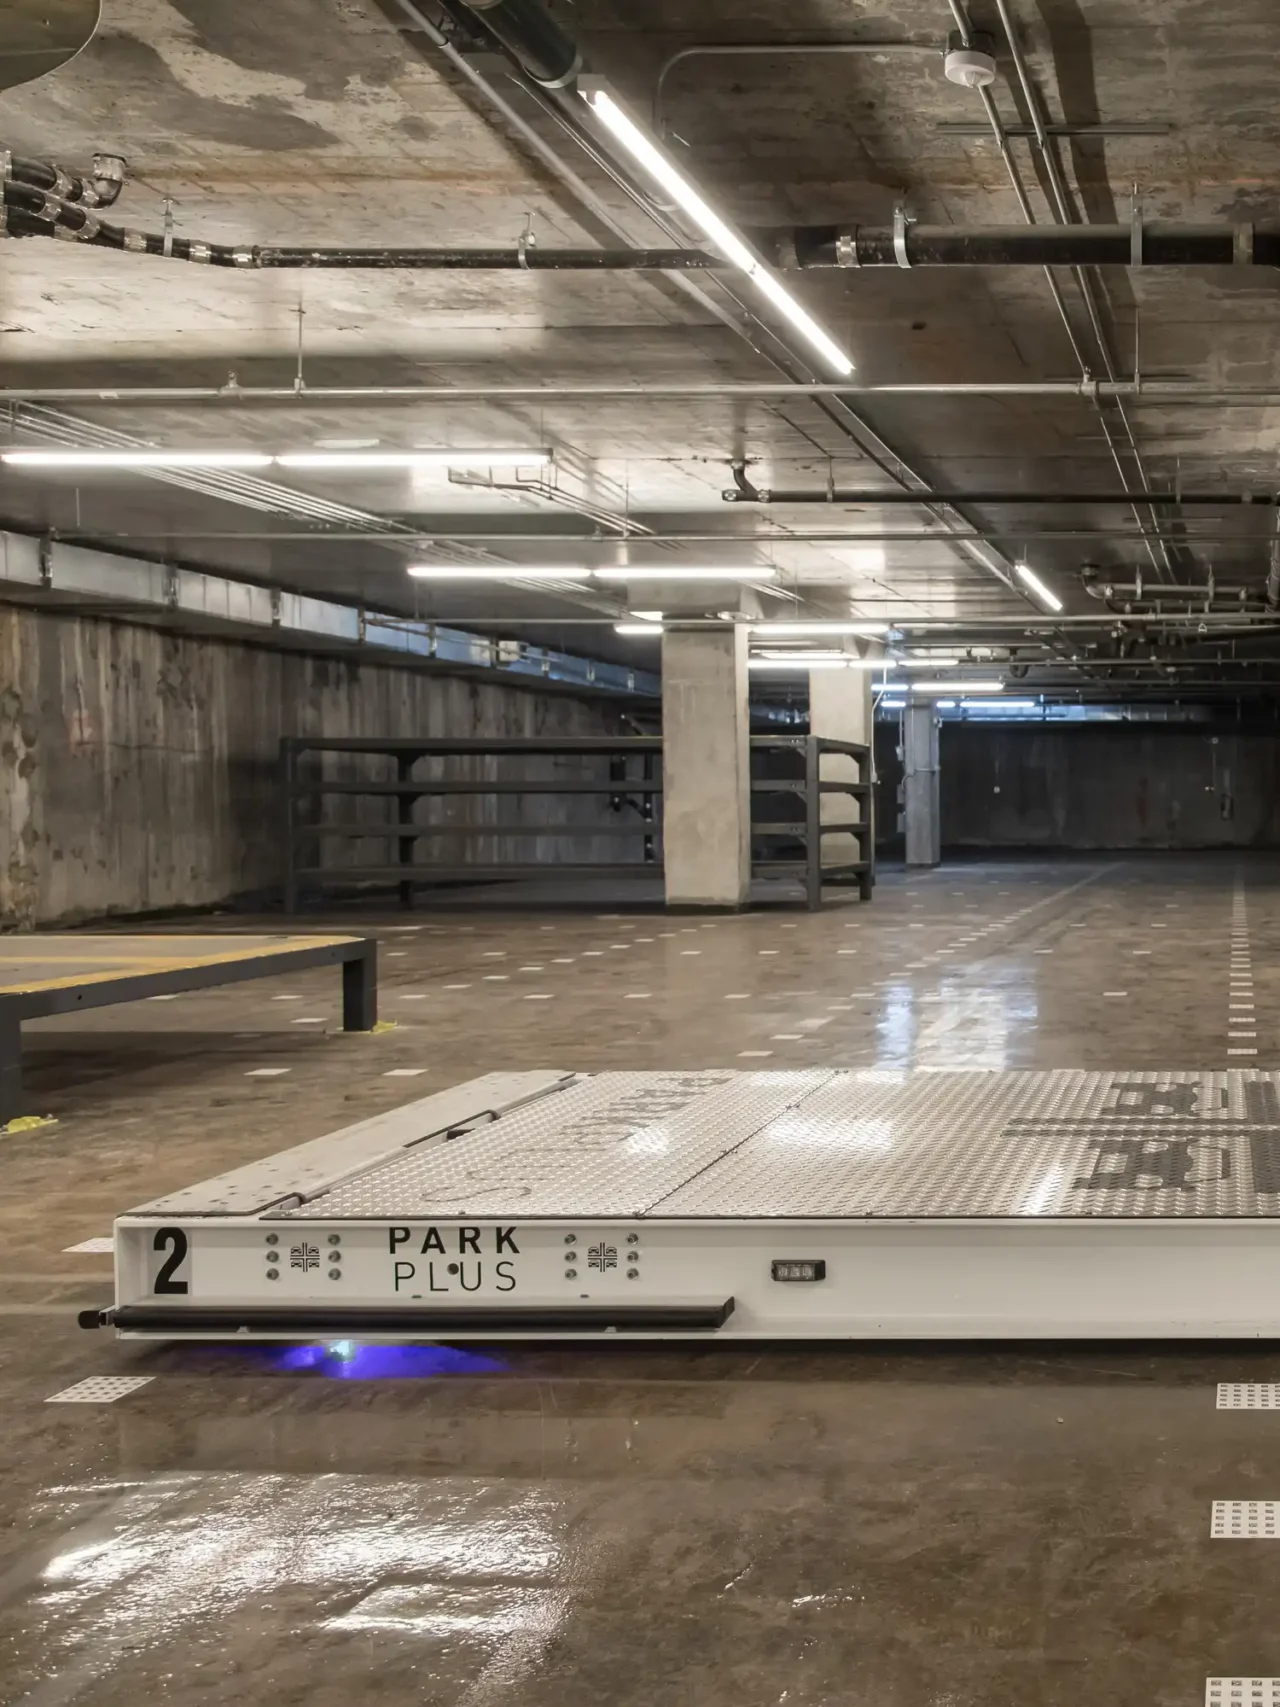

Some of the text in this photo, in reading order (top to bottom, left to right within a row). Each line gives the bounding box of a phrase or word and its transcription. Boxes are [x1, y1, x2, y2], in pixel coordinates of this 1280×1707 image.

[388, 1226, 521, 1254] PARK
[152, 1226, 189, 1295] 2
[394, 1261, 516, 1292] PLUS
